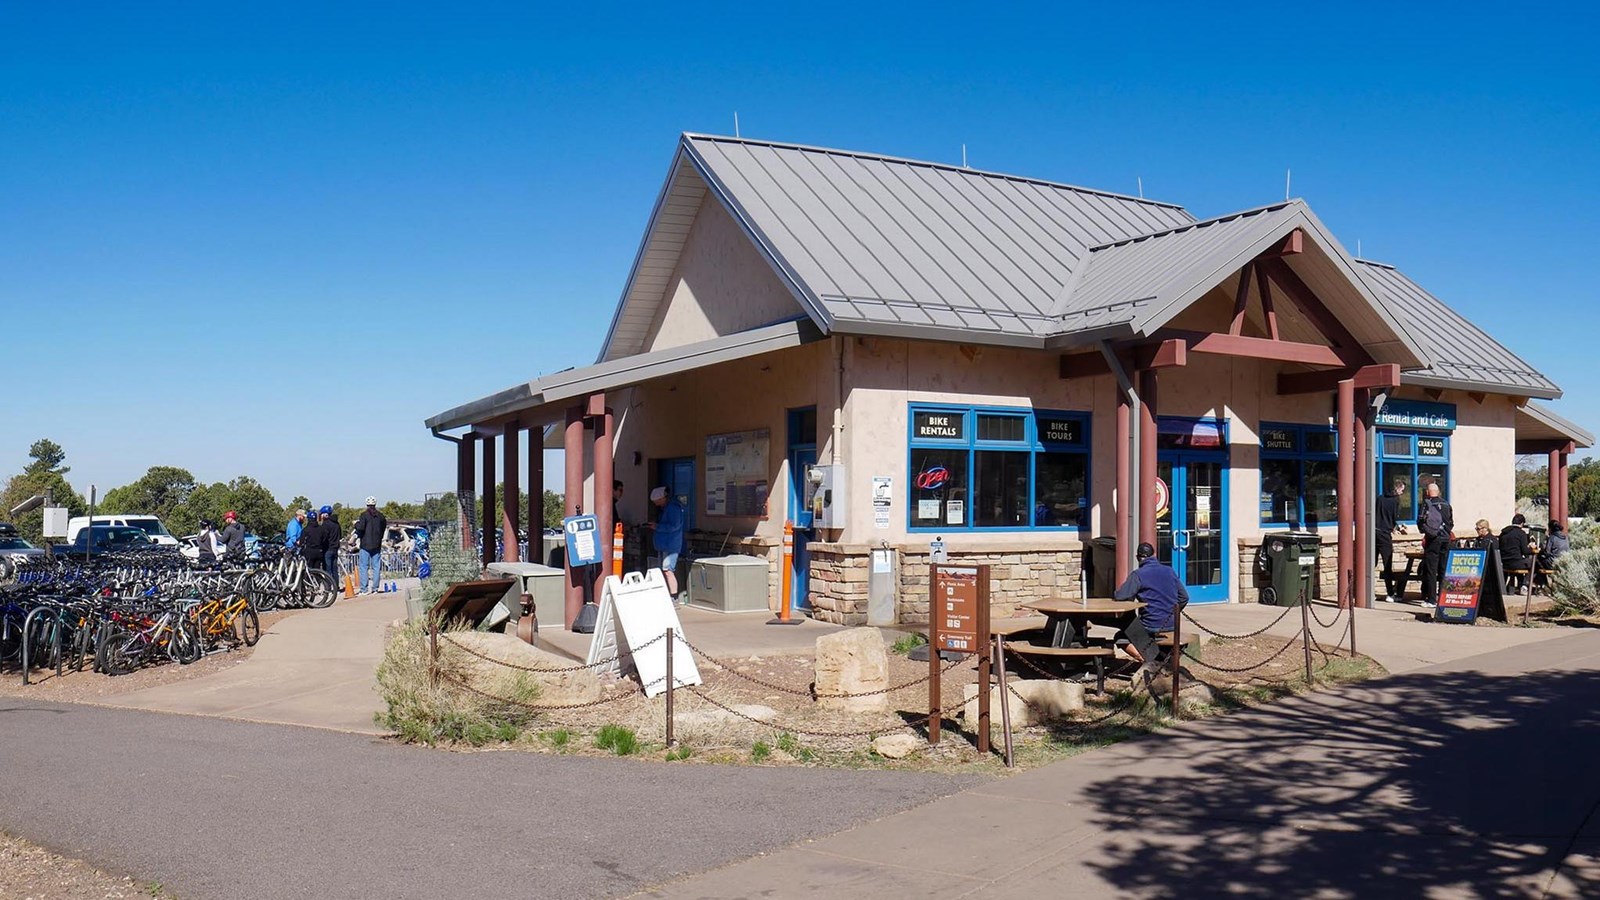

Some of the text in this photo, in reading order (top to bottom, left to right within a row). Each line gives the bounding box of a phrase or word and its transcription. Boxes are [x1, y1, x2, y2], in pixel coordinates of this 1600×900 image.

[929, 417, 948, 426] BIKE
[1382, 411, 1410, 424] Rental
[1411, 412, 1429, 426] and
[920, 426, 956, 436] RENTALS
[1051, 422, 1068, 431] BIKE
[1047, 431, 1072, 440] TOURS
[1272, 432, 1285, 440] BIKE
[1266, 440, 1291, 448] SHUTTLE
[1452, 557, 1480, 565] BICYCLE
